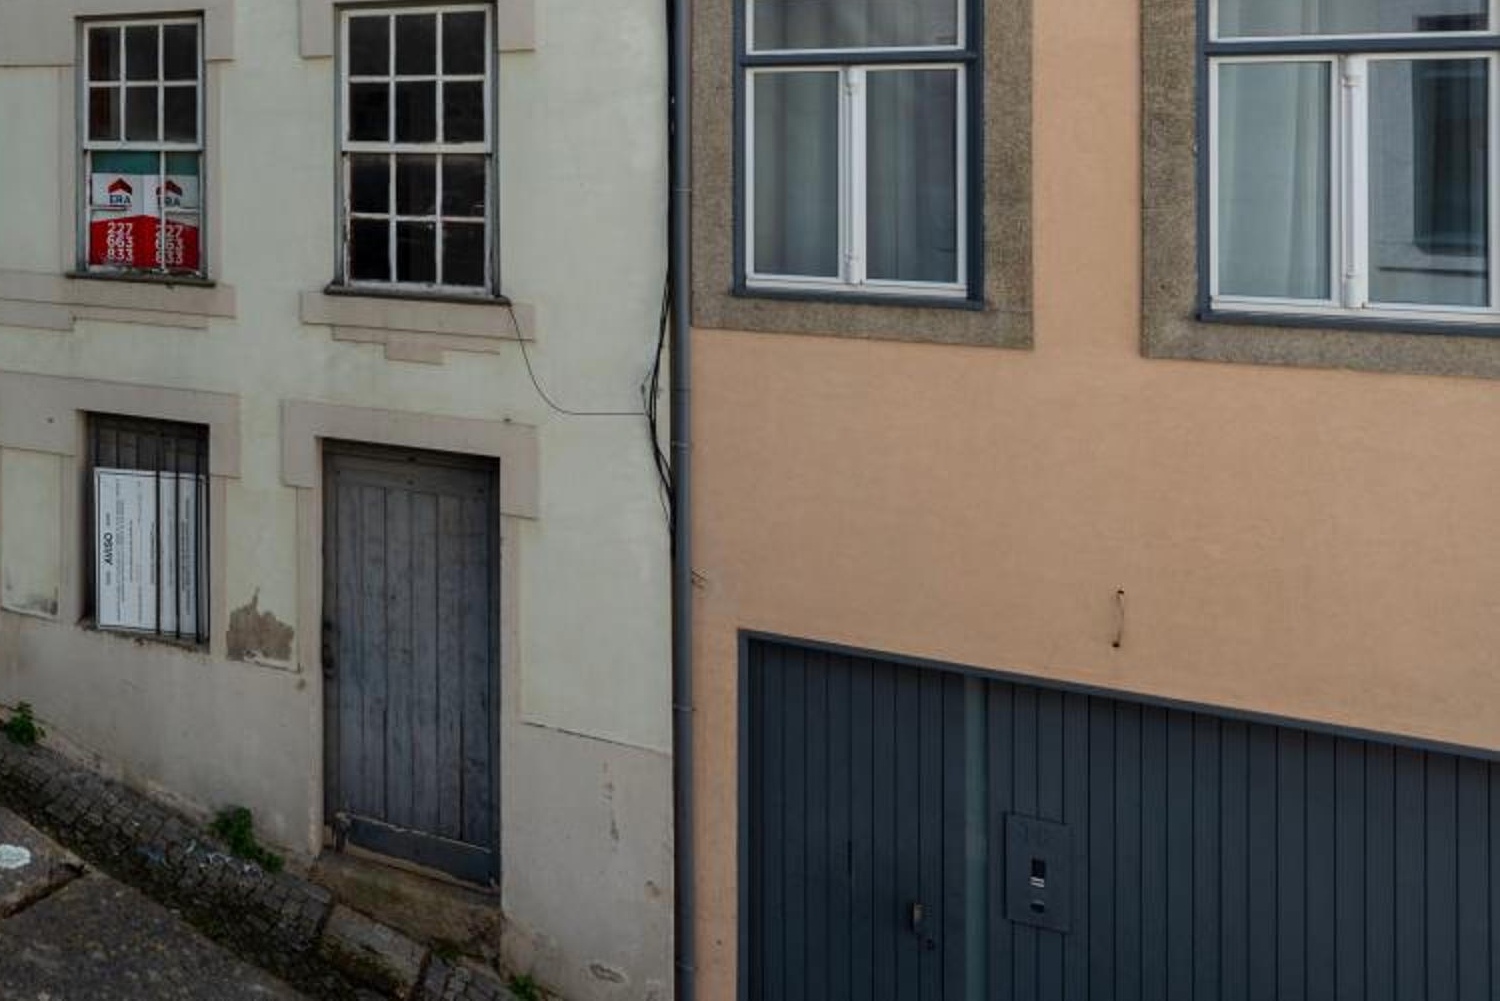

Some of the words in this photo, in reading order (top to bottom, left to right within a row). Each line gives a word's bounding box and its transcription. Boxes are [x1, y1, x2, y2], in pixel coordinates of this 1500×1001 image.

[109, 194, 131, 205] ERA
[107, 222, 133, 235] 227
[107, 235, 133, 248] 663
[107, 248, 133, 261] 833
[103, 532, 114, 566] AVISO
